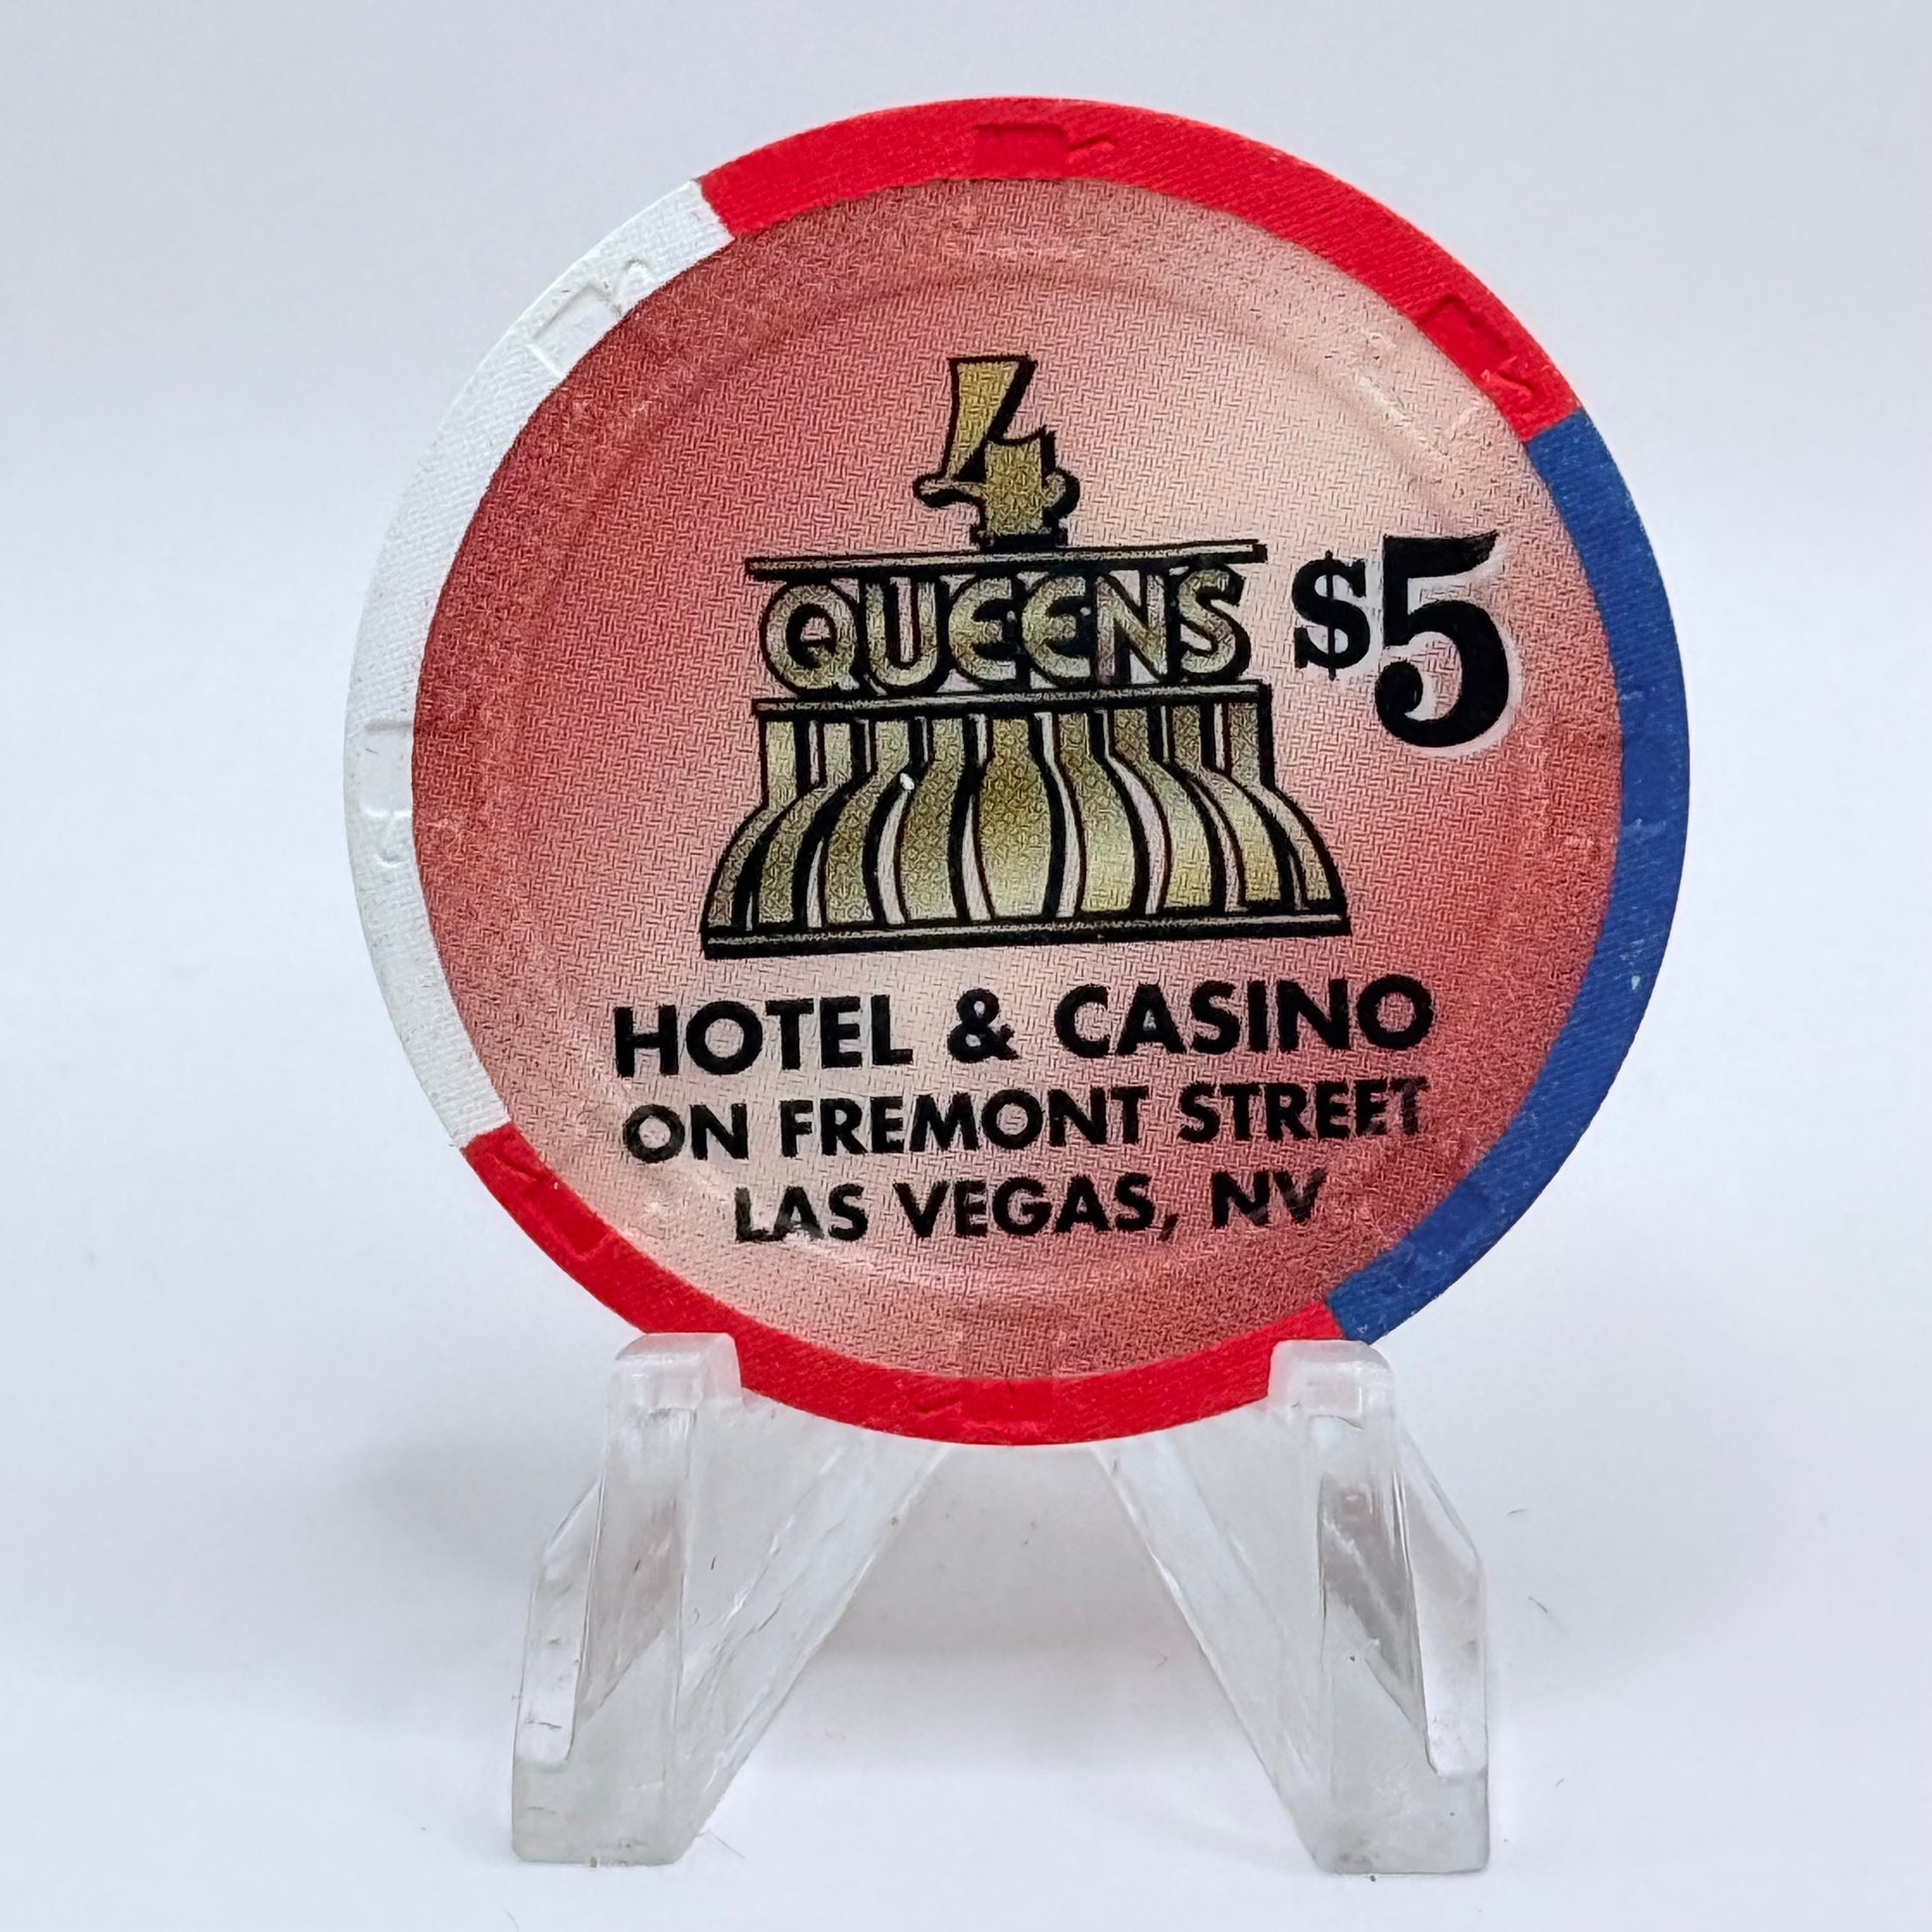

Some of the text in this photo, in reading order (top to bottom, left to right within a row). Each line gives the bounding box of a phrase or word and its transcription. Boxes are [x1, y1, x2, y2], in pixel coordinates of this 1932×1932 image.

[912, 353, 1080, 547] 4
[759, 563, 1252, 696] QUEENS
[1292, 531, 1509, 748] $5
[614, 974, 1435, 1078] HOTEL & CASINO
[622, 1076, 1431, 1164] ON FREMONT STREET
[735, 1168, 1325, 1242] LAS VEGAS, NV
